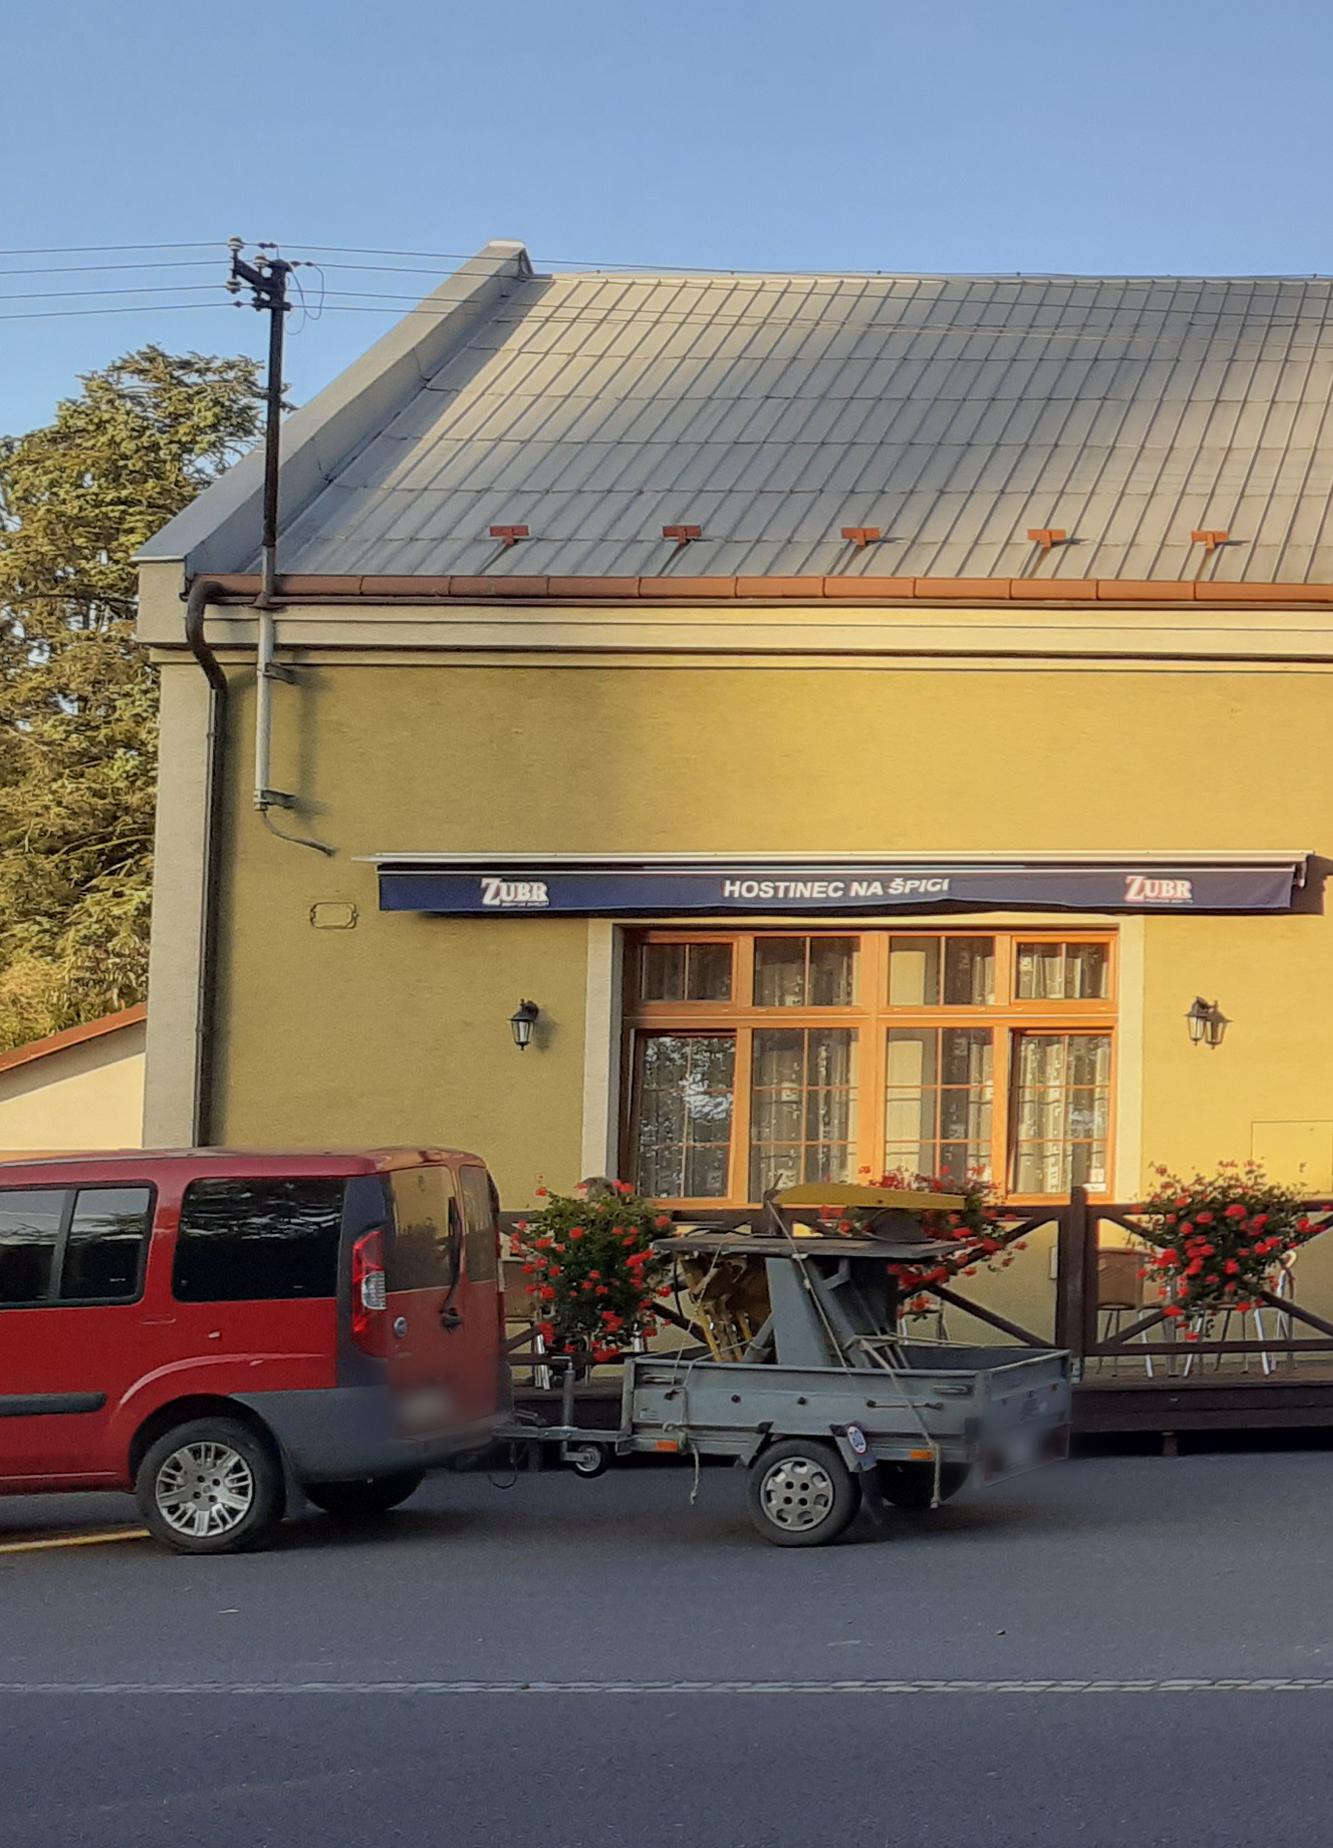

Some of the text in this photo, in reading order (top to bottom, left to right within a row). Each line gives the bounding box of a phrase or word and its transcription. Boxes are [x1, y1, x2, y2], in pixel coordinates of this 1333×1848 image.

[480, 877, 549, 905] ZUBR
[723, 879, 845, 898] HOSTINEC
[850, 881, 883, 897] NA
[1124, 875, 1192, 903] ZUBR
